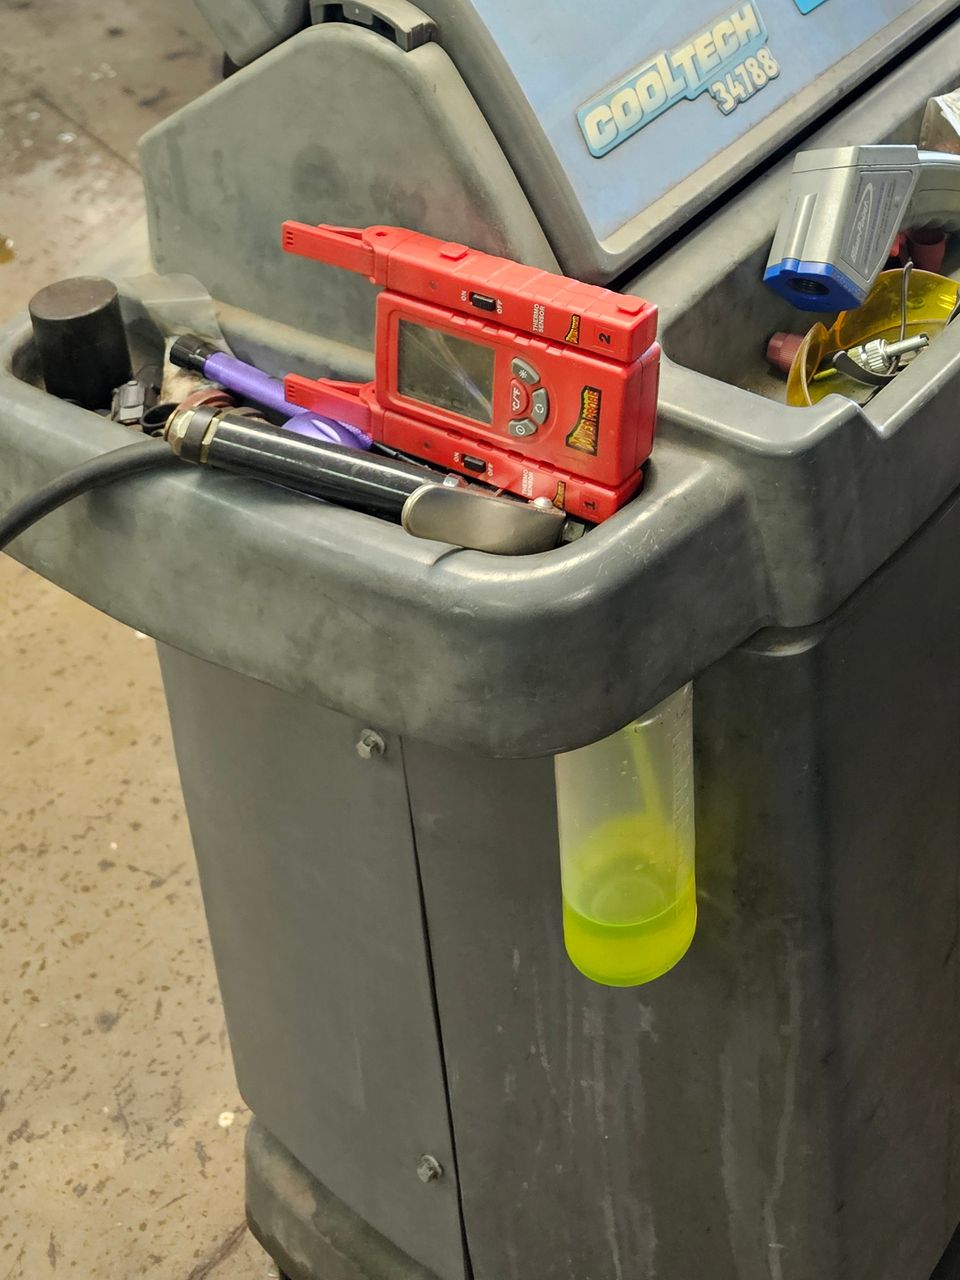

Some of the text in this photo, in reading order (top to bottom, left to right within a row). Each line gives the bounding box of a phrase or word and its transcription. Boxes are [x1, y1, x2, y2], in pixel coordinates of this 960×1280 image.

[584, 3, 763, 151] COOLTECH
[711, 46, 780, 113] 34788
[460, 289, 467, 302] ON
[532, 303, 540, 333] THERMO
[537, 305, 545, 333] SENSOR
[598, 332, 611, 345] 2
[567, 388, 600, 451] POWER PROBE
[453, 451, 460, 463] ON
[521, 468, 529, 496] THERMO
[583, 500, 596, 510] 1
